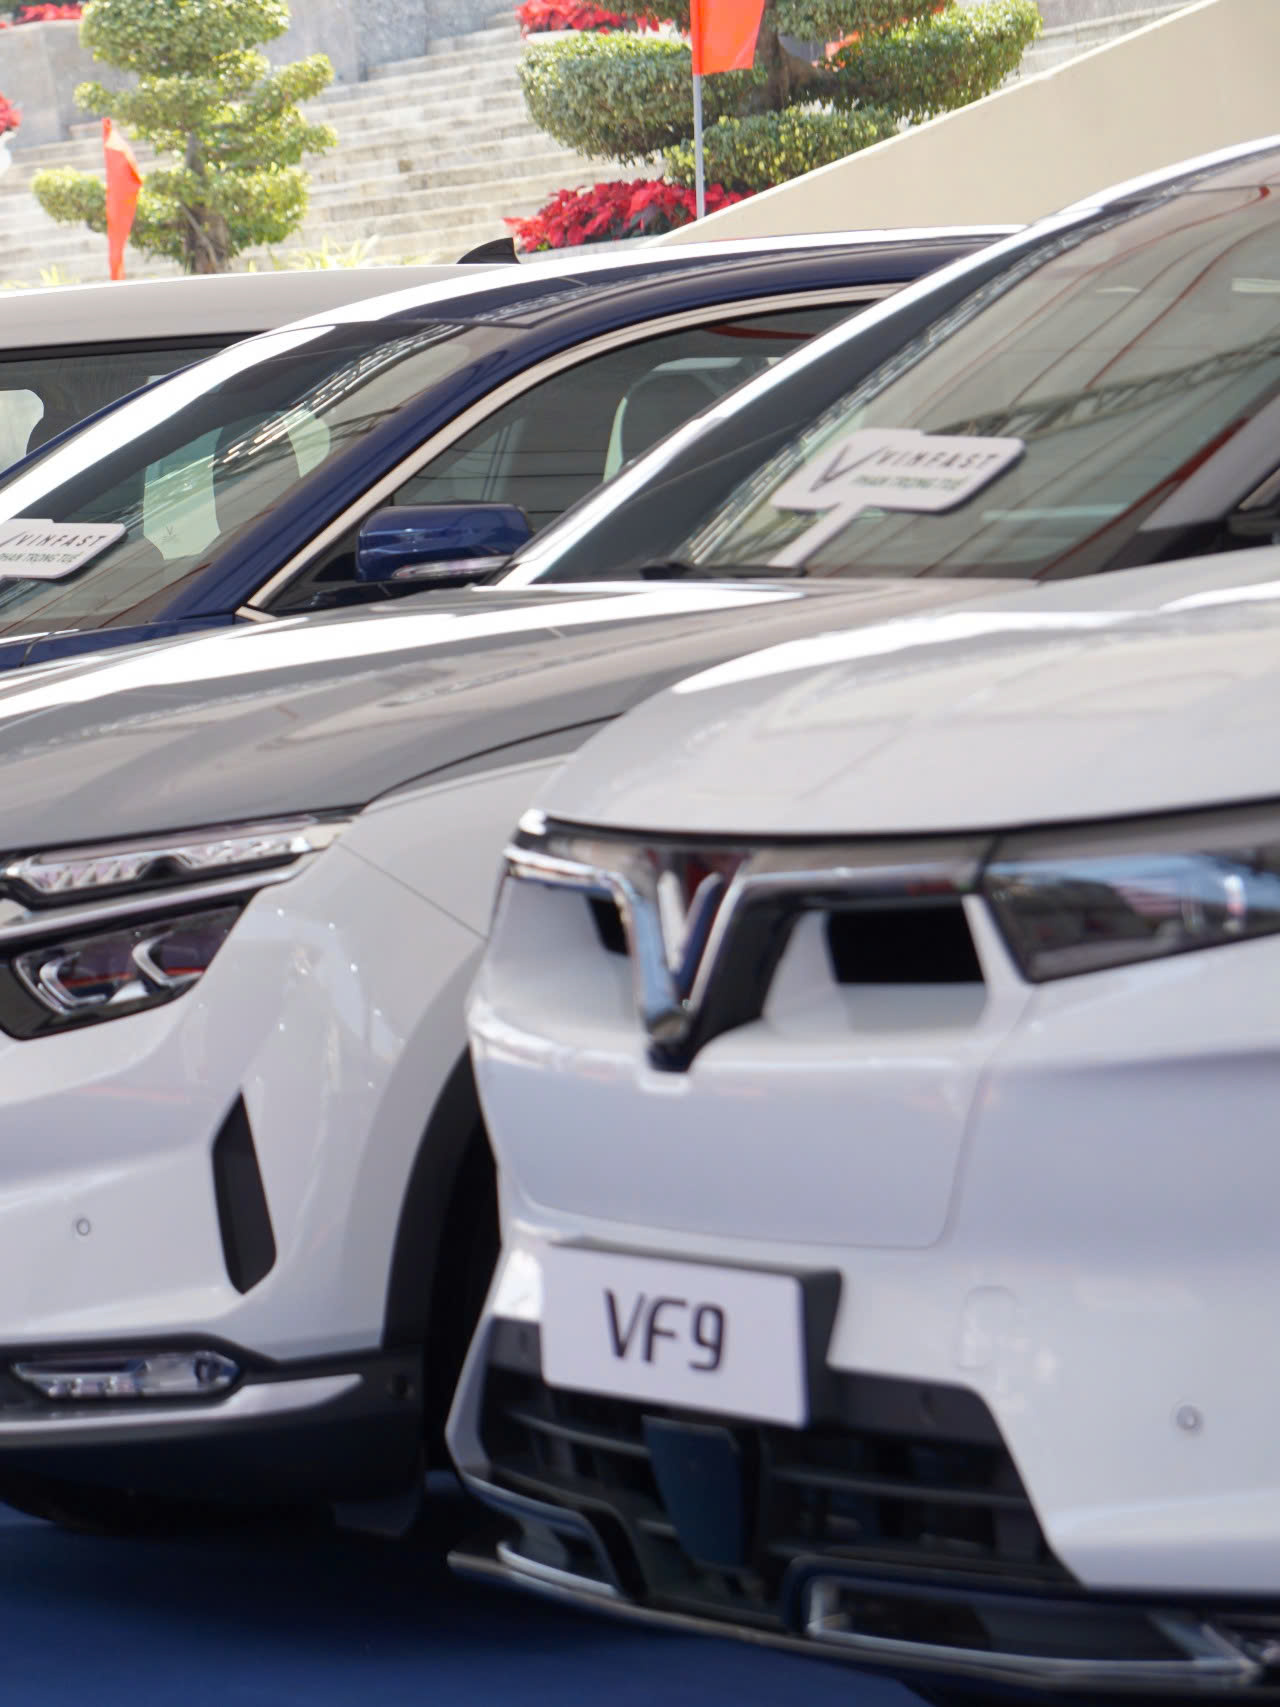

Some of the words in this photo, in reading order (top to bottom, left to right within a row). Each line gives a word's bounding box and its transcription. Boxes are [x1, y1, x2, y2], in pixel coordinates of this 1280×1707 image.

[876, 450, 998, 469] VINFAST
[16, 534, 107, 547] VINFAST
[604, 1286, 726, 1374] VF9
